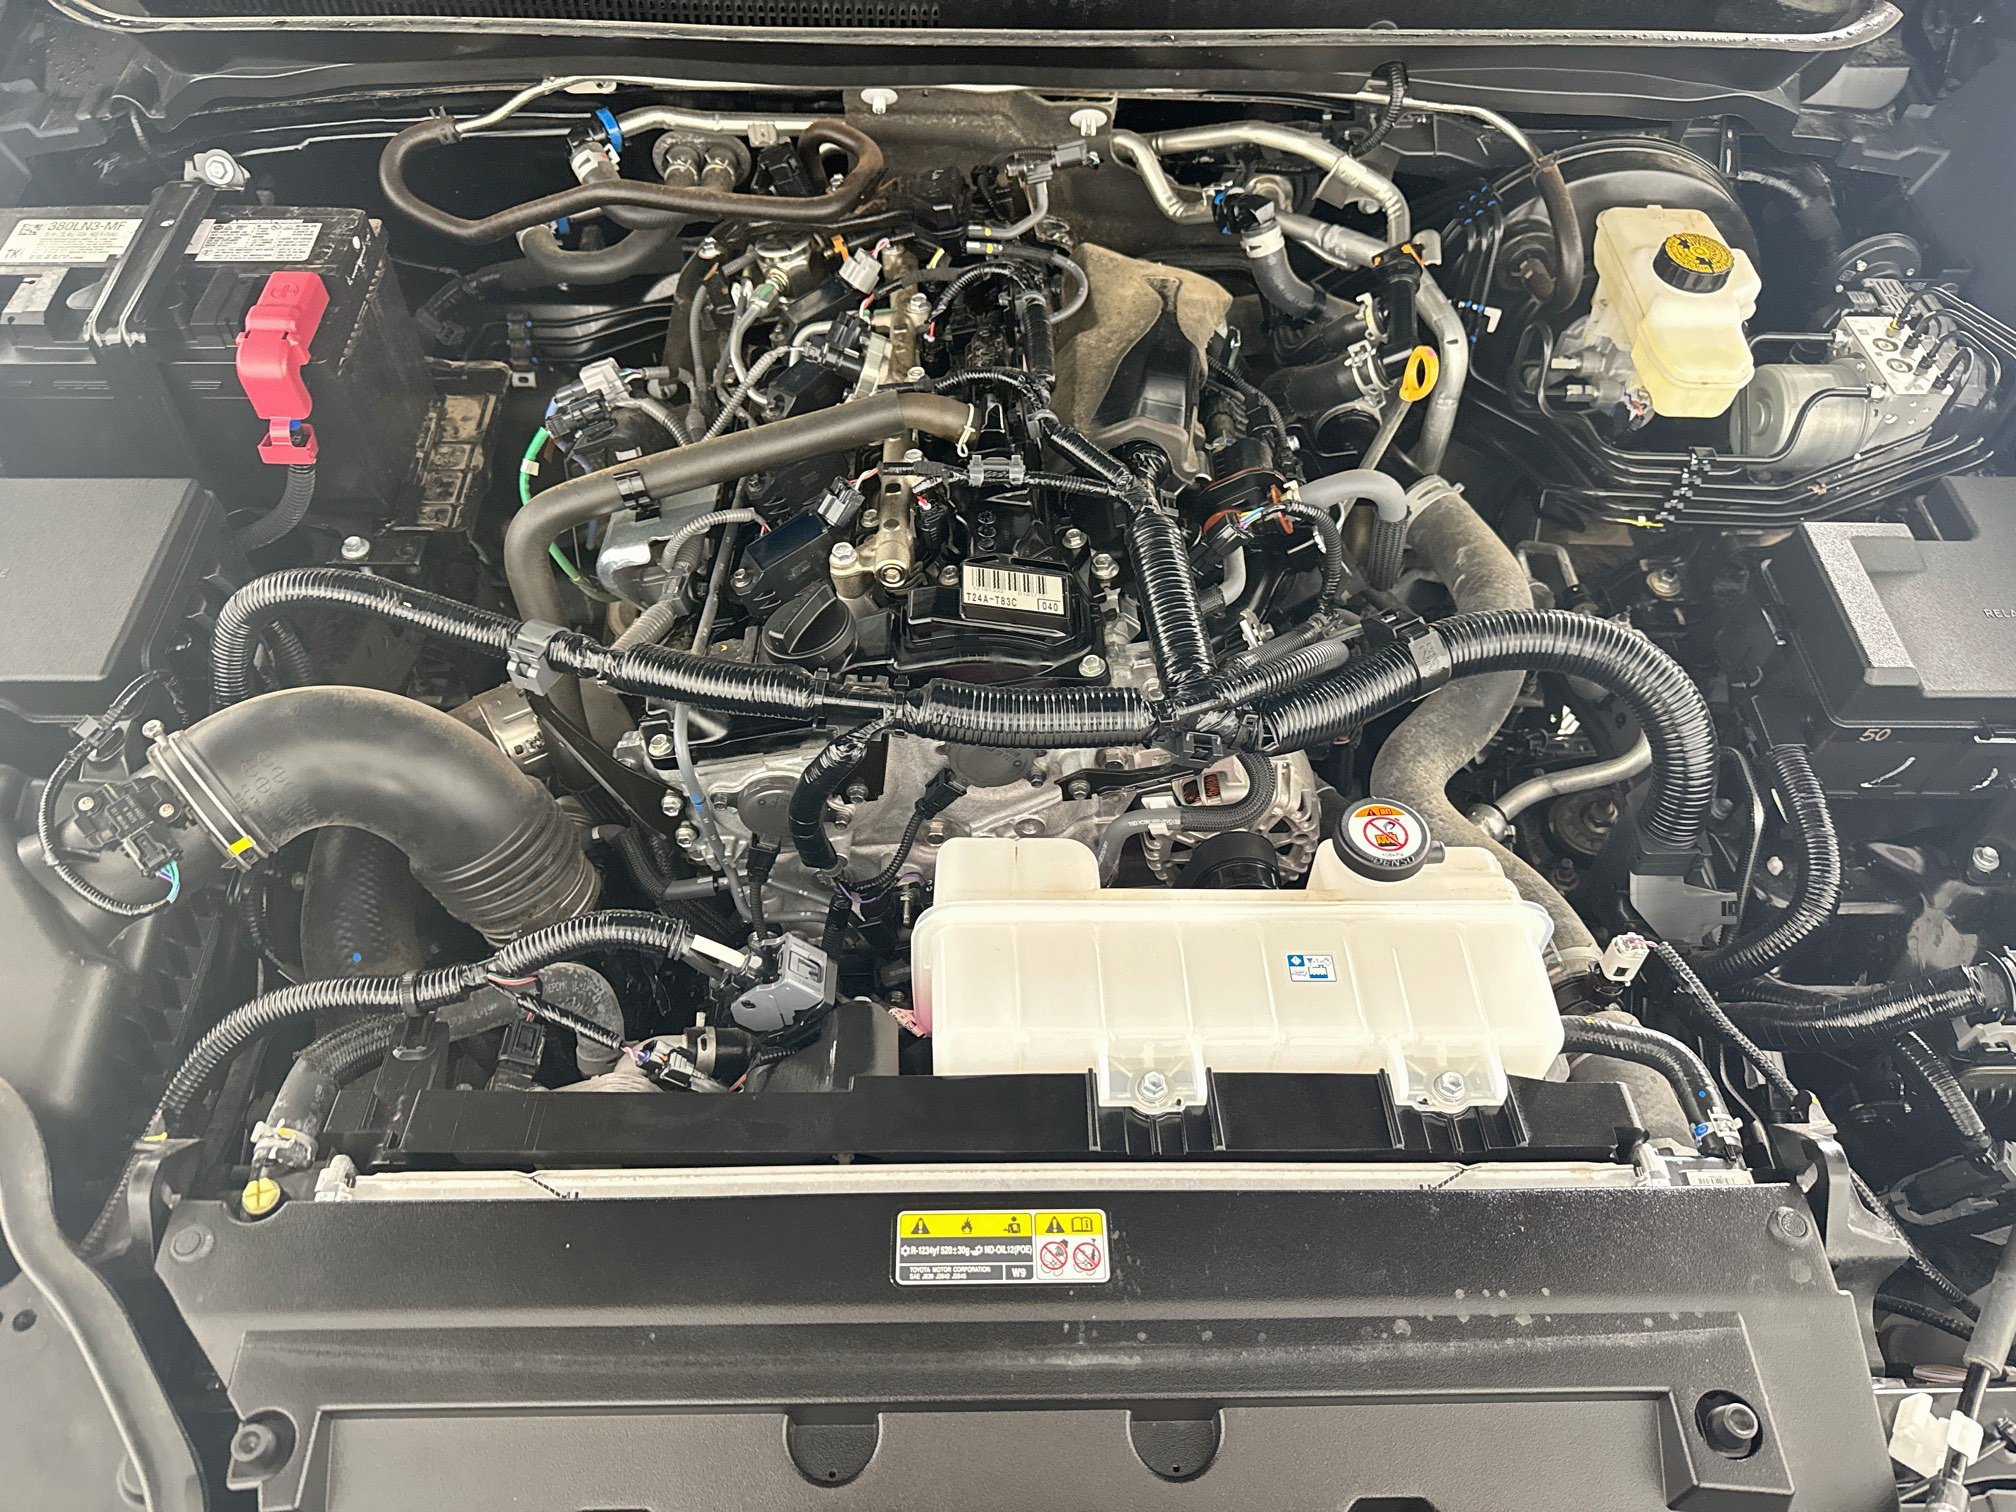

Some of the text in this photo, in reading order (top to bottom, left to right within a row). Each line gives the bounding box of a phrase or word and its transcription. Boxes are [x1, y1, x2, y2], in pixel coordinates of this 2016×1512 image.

[47, 221, 127, 231] 380LN3-MF
[966, 592, 1018, 607] T24A-T83C
[1042, 602, 1059, 612] 040
[1859, 728, 1892, 742] 50
[1373, 855, 1415, 867] DENSO
[1011, 1267, 1027, 1278] W9
